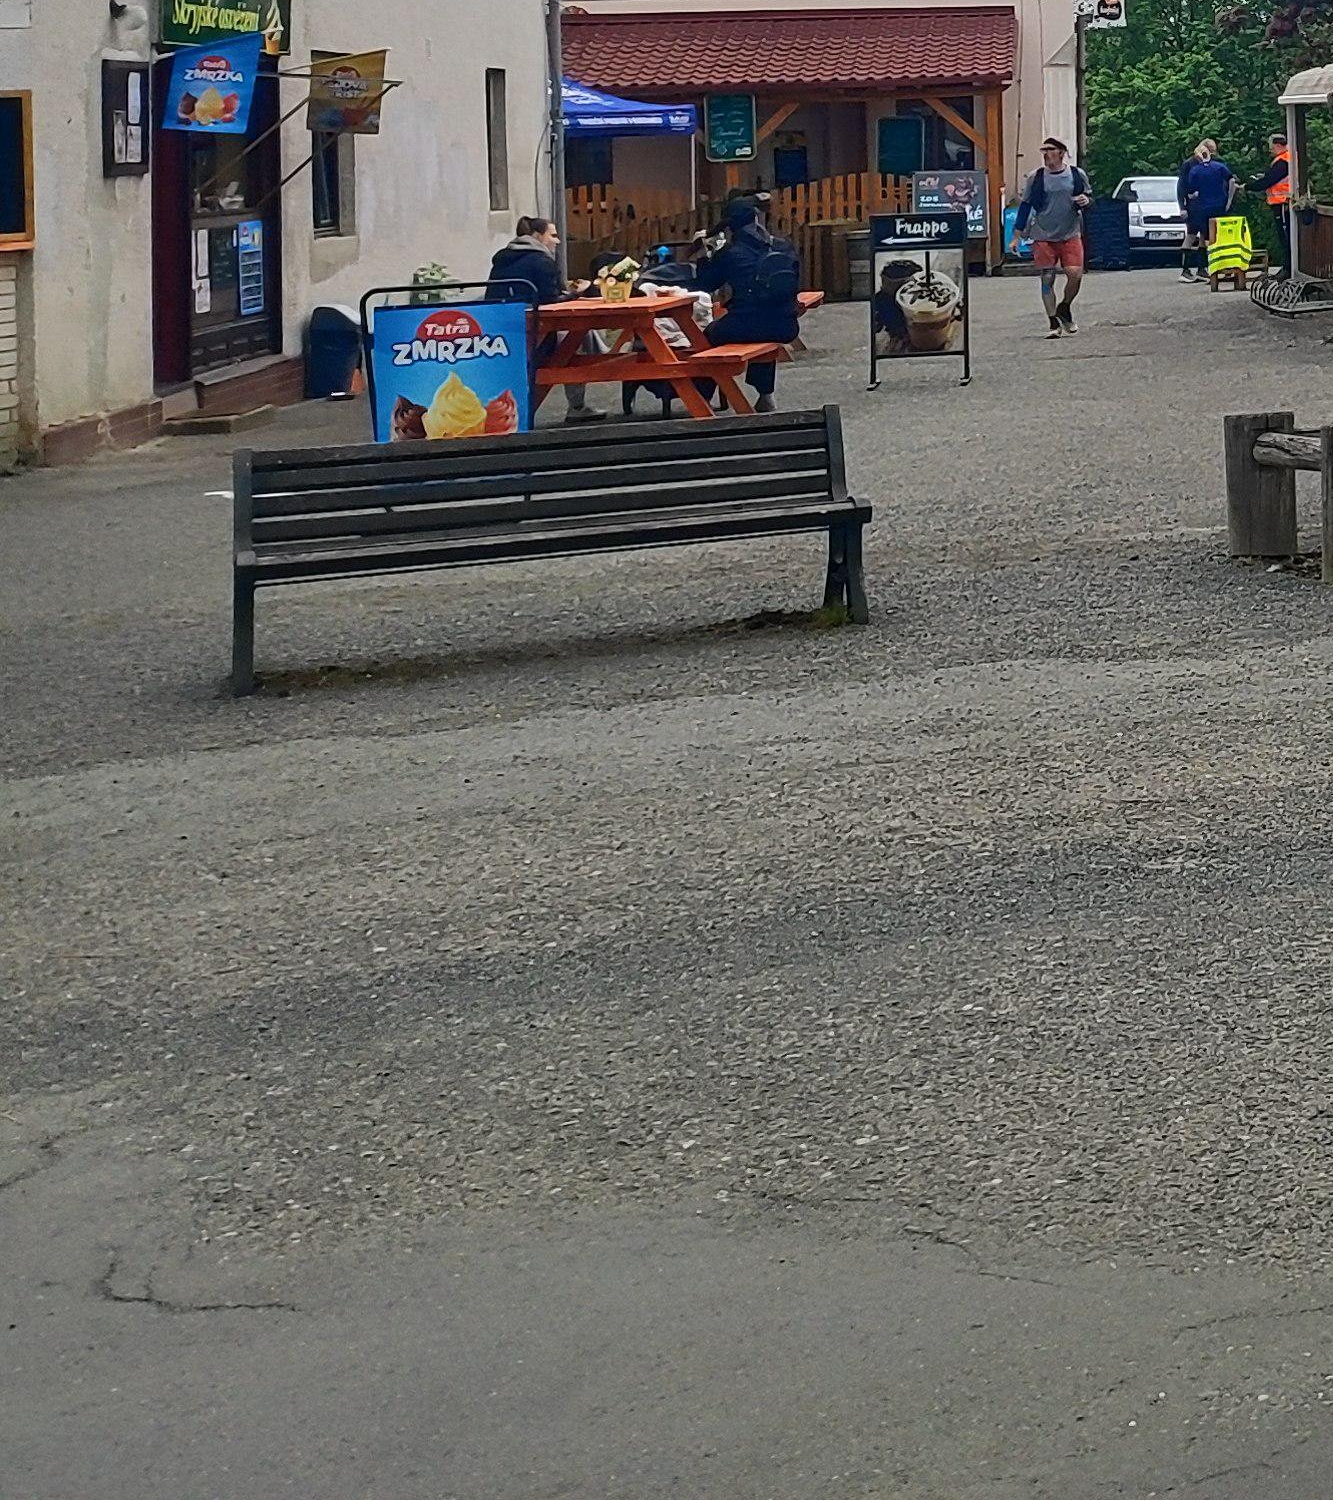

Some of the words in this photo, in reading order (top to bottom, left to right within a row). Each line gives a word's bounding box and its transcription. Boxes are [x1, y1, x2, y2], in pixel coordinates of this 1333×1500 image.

[184, 67, 244, 83] ZMRZKA
[895, 218, 950, 238] Frappe
[424, 318, 471, 337] Tatra
[392, 335, 509, 367] ZMRZKA
